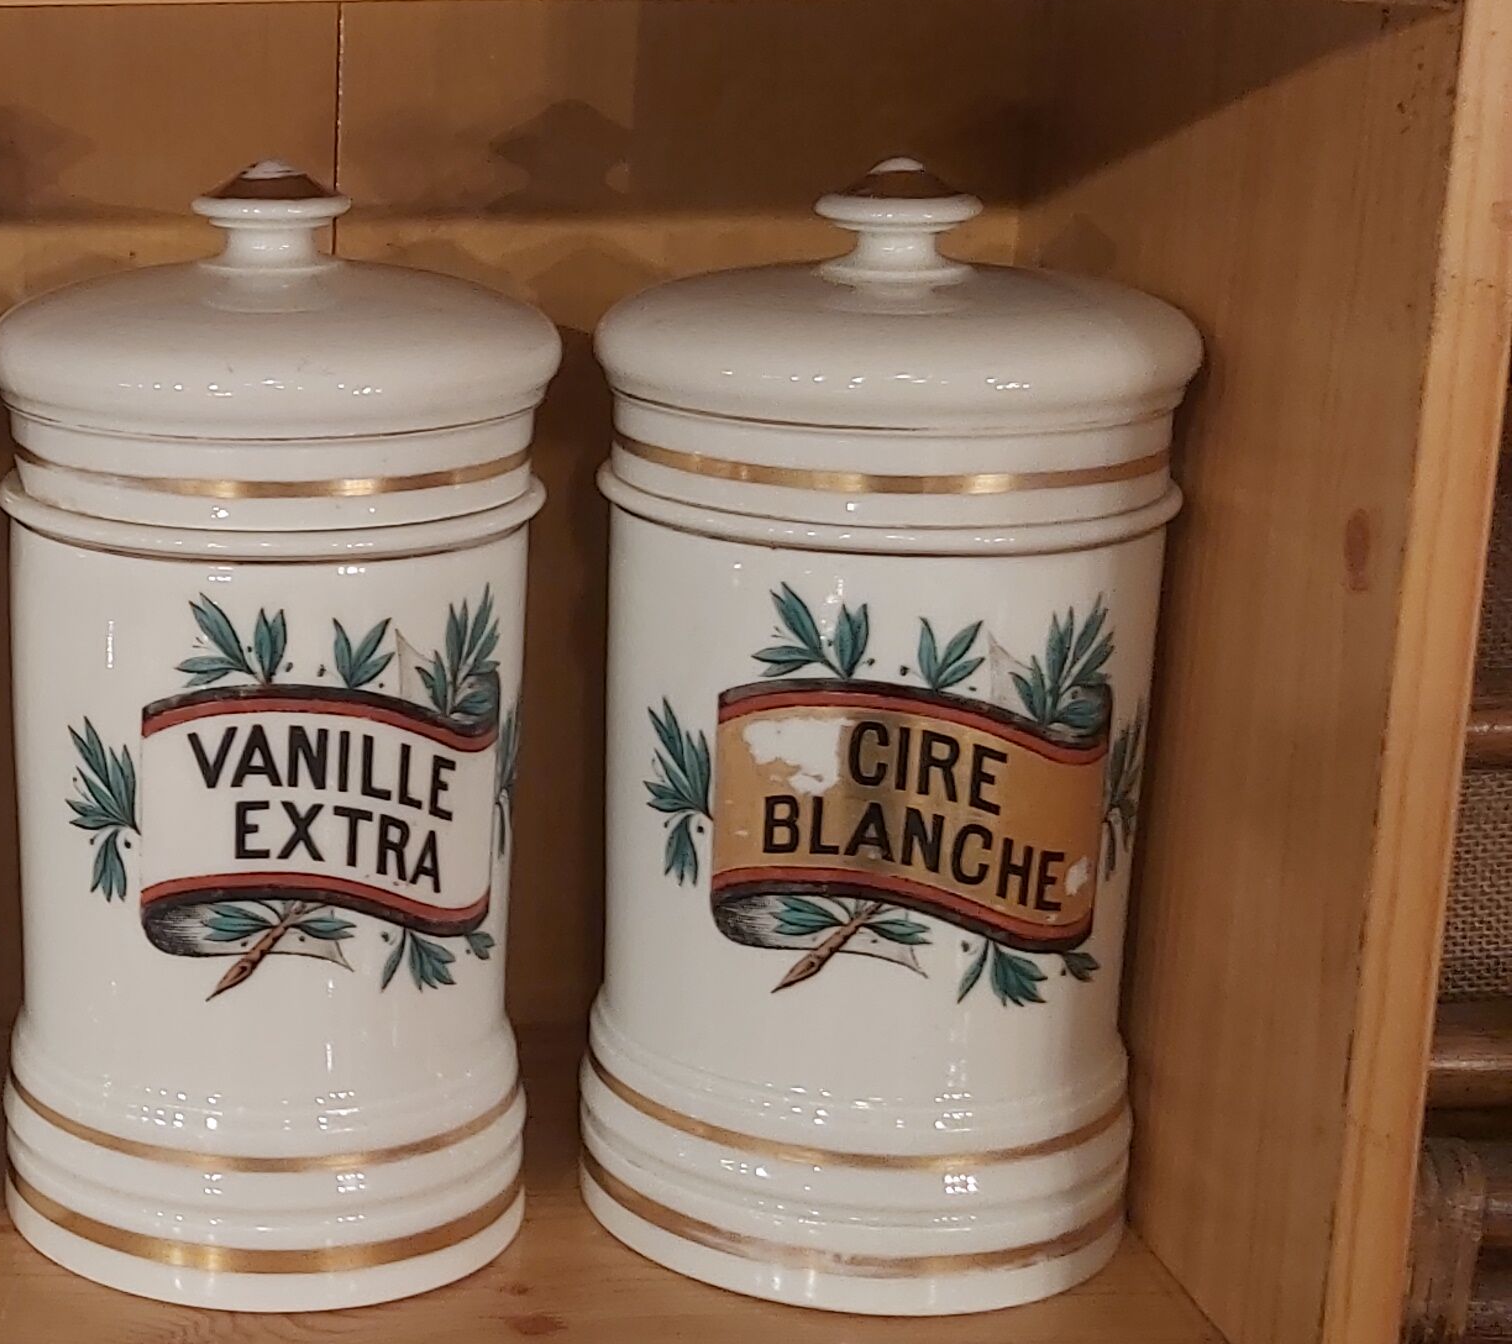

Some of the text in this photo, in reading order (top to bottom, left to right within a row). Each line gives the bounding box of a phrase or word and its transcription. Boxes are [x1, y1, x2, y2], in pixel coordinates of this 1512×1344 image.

[187, 724, 456, 821] VANILLE
[849, 721, 1008, 816] CIRE
[235, 800, 441, 893] EXTRA
[763, 794, 1065, 911] BLANCHE
